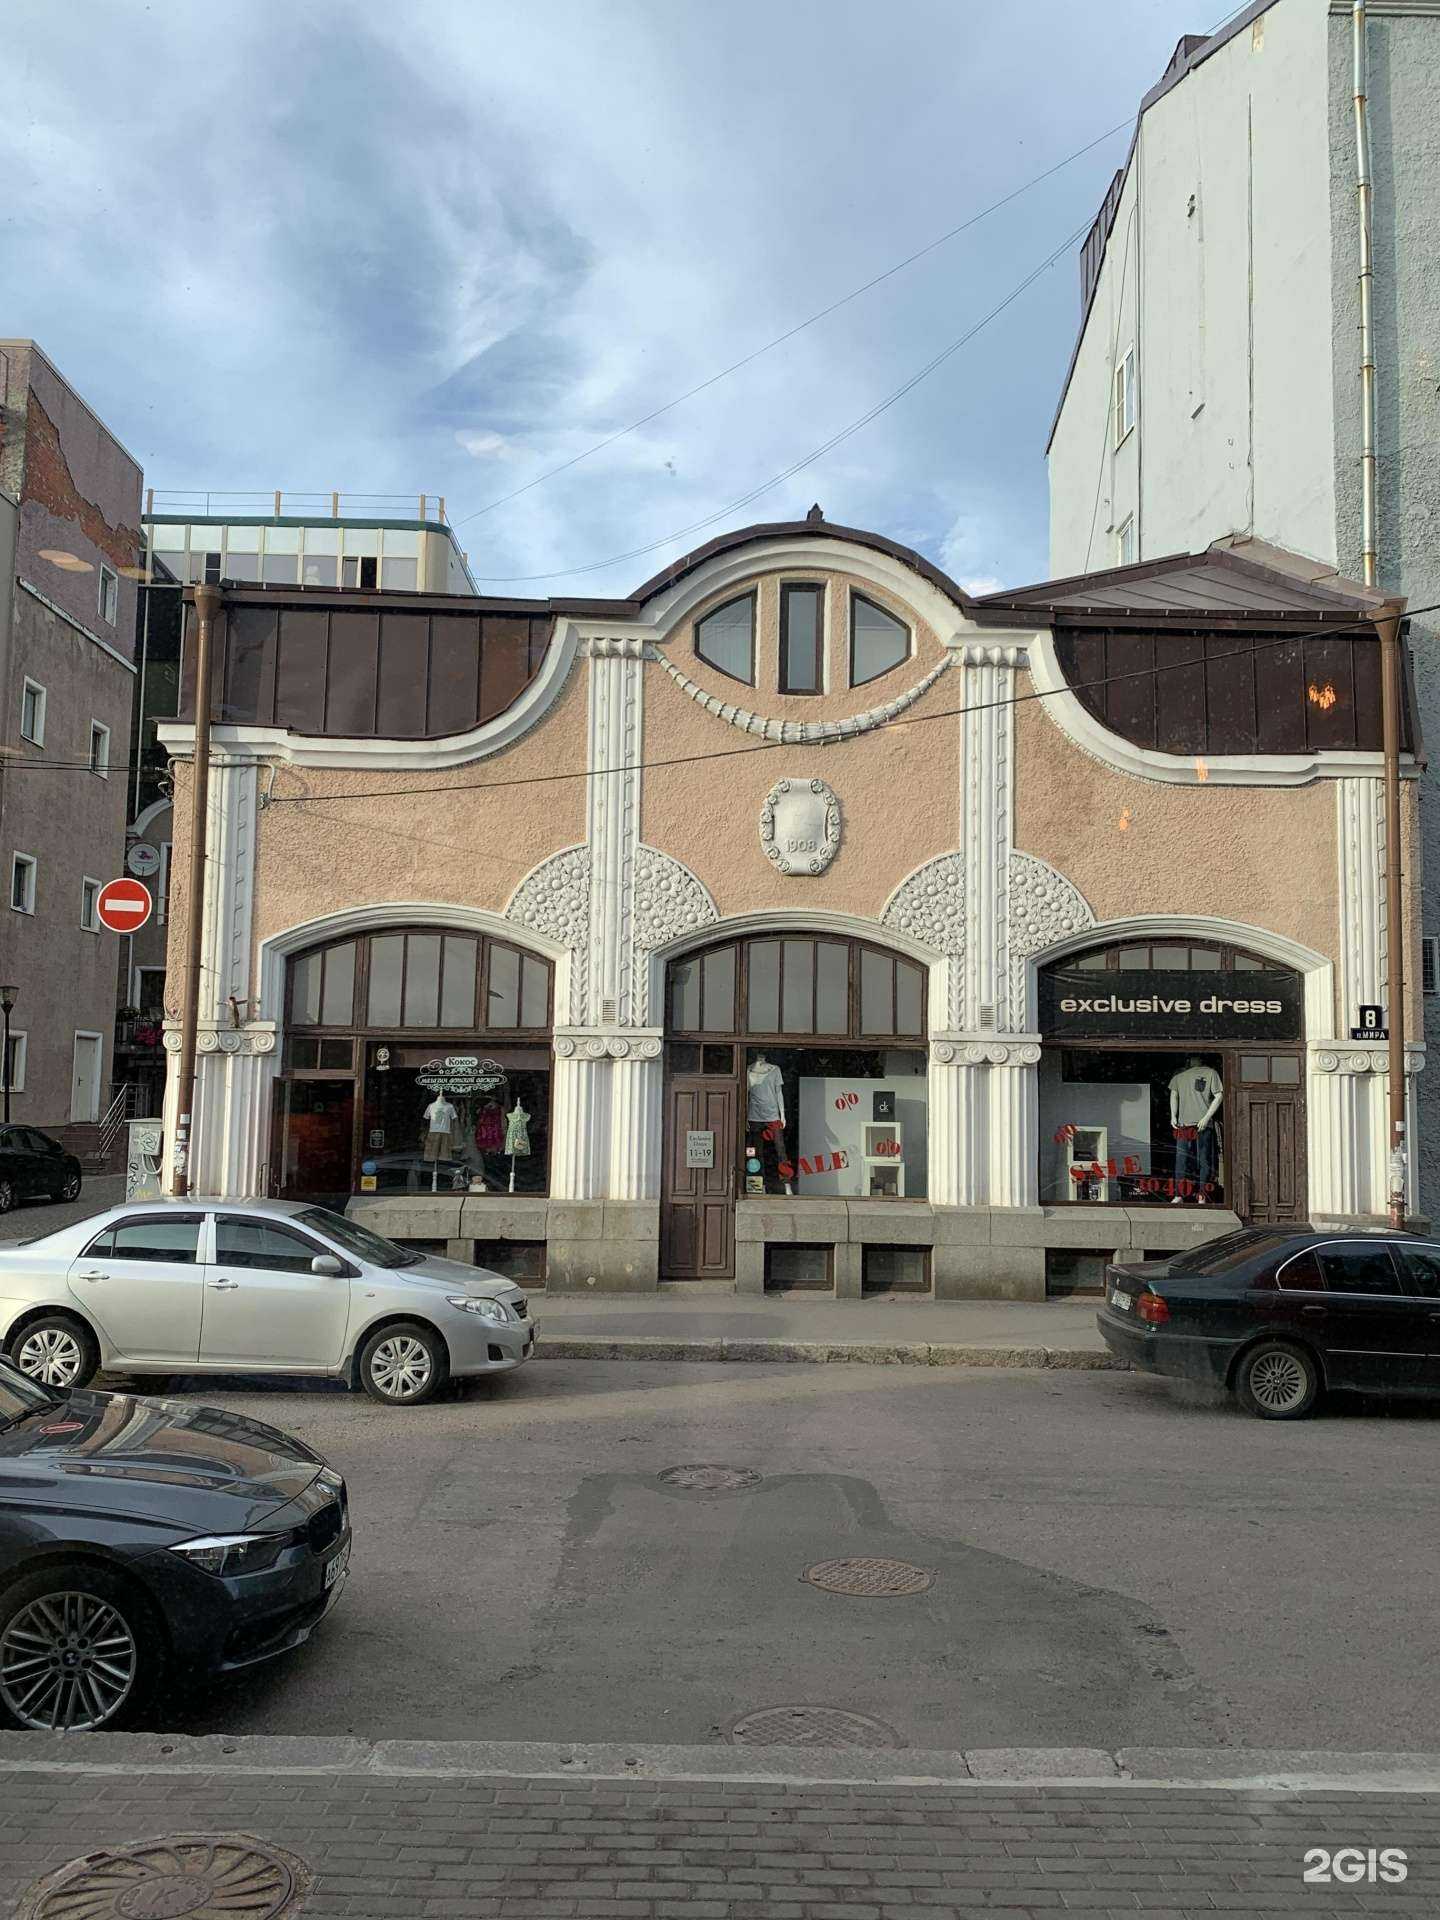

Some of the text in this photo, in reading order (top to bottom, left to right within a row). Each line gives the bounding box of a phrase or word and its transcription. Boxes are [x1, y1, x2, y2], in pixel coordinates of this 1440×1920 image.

[786, 839, 817, 853] 1908
[1060, 994, 1282, 1014] exclusive dress
[1365, 1009, 1376, 1028] 8
[448, 1057, 476, 1066] Кокос
[778, 1151, 850, 1178] SALE
